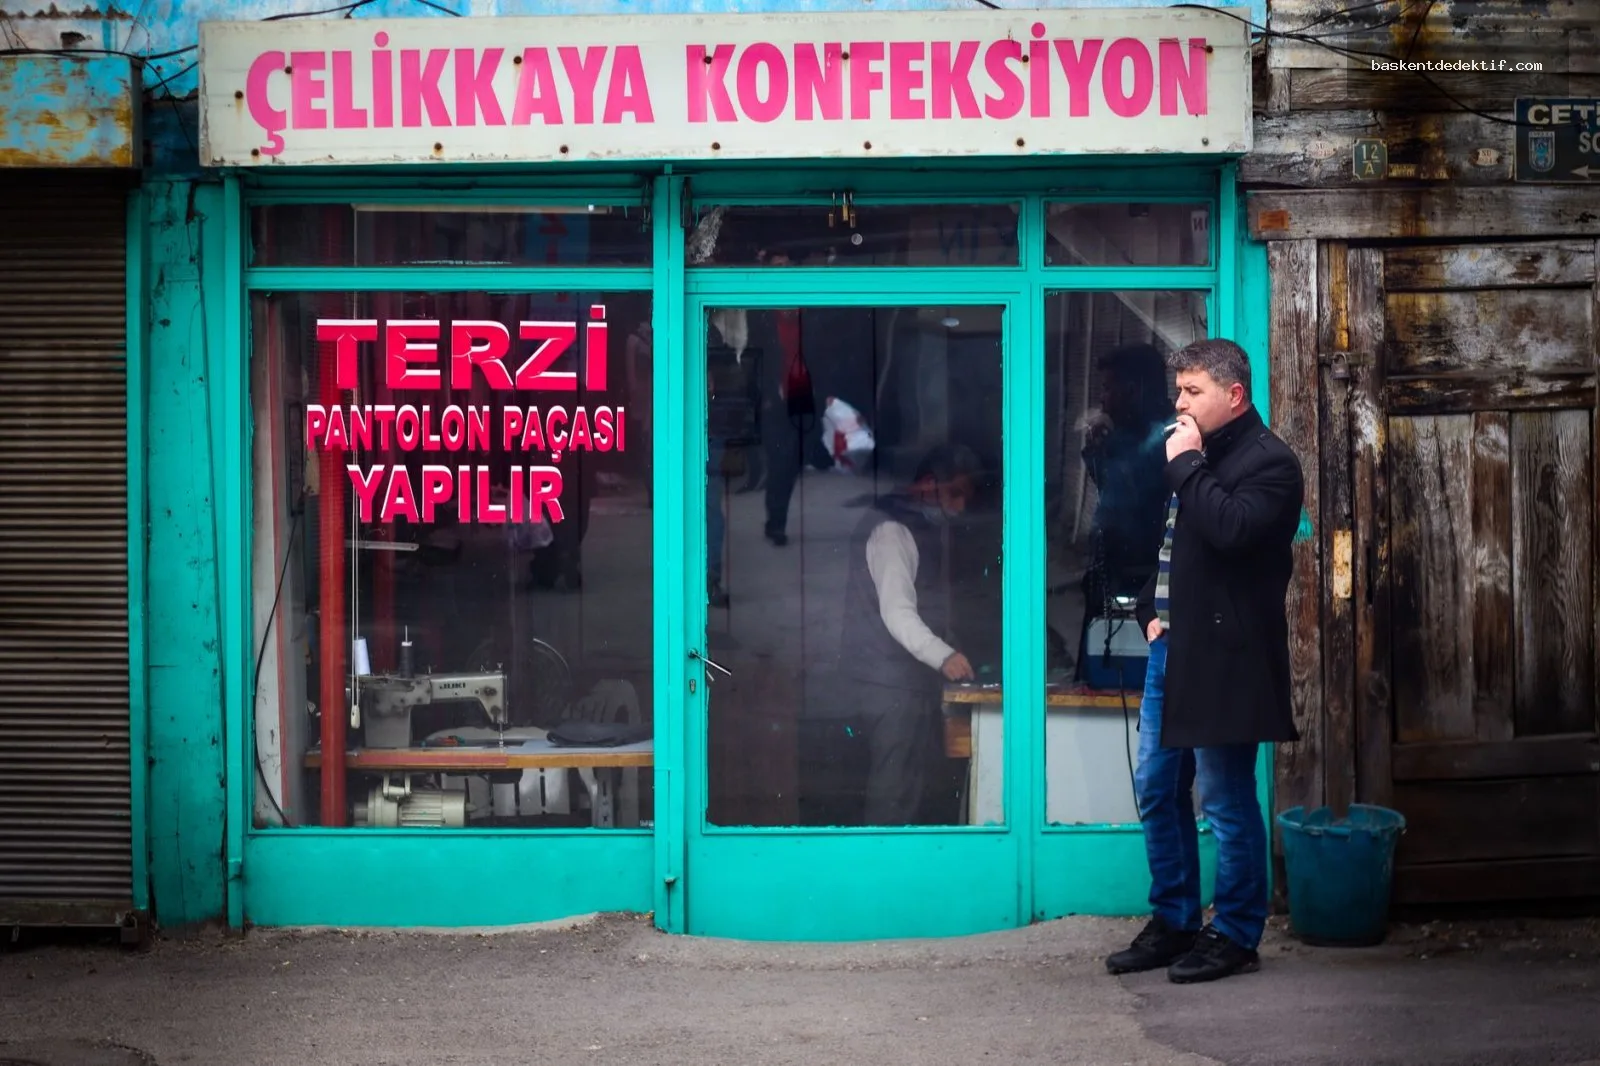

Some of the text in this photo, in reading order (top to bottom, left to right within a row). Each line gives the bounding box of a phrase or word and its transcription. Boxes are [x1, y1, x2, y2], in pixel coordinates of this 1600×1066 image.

[246, 22, 1208, 156] ÇELİKKAYA KONFEKSİYON
[1361, 143, 1380, 160] 12
[1364, 161, 1375, 175] A
[316, 304, 608, 391] TERZİ
[306, 404, 625, 463] PANTOLON PAÇASI
[347, 464, 564, 523] YAPILIR
